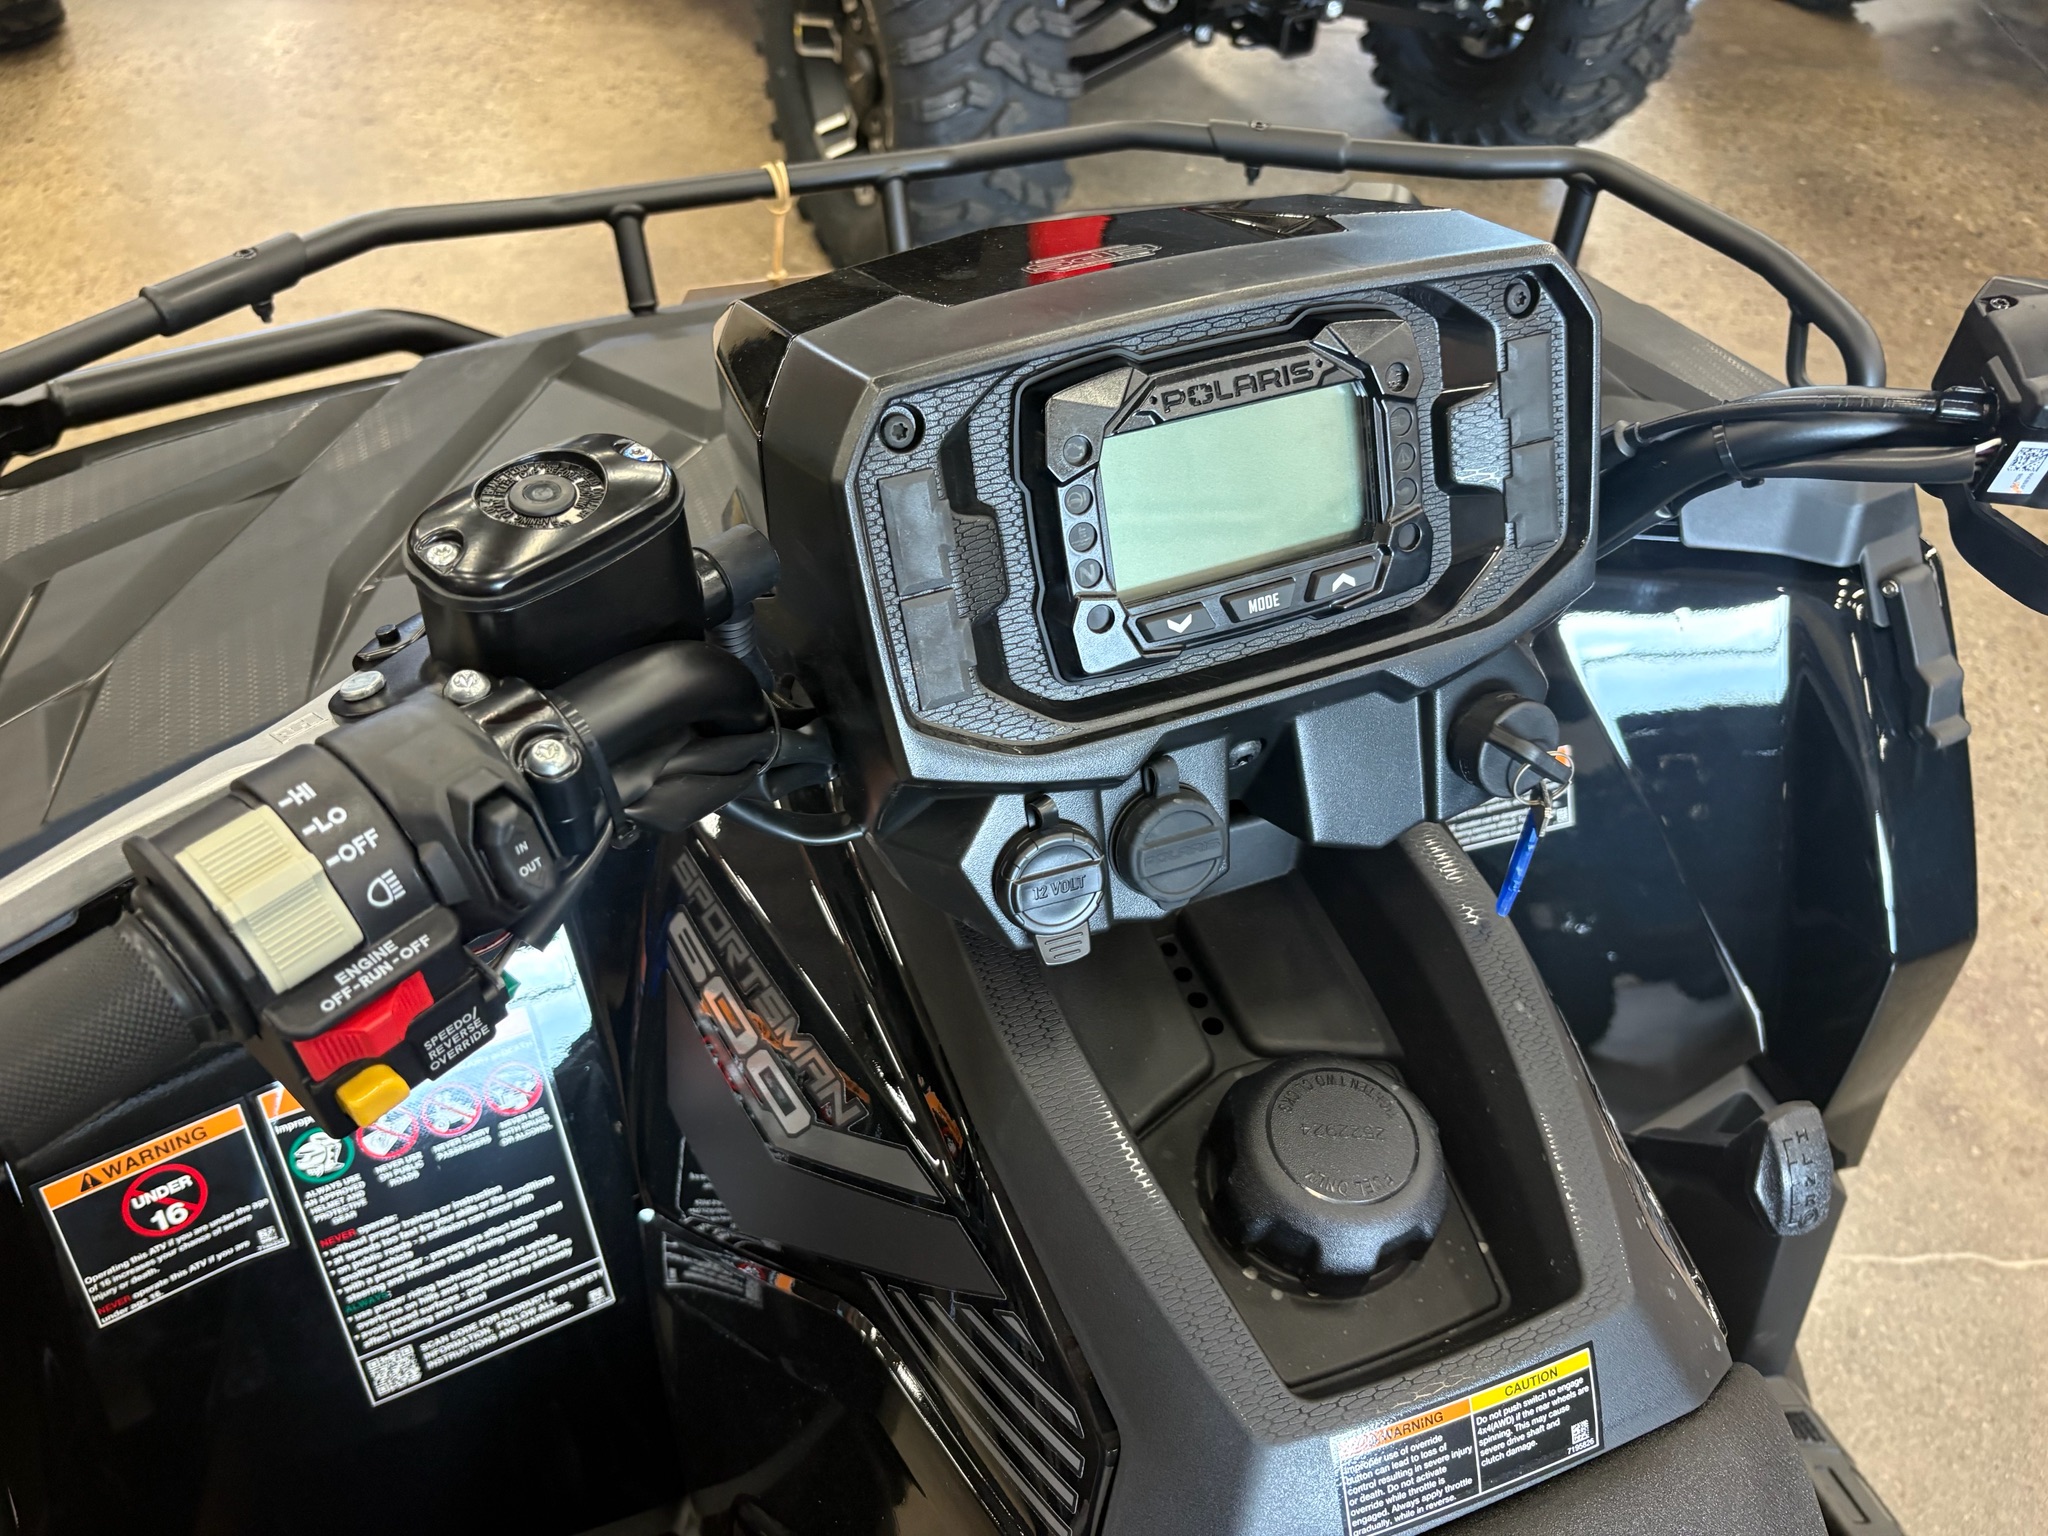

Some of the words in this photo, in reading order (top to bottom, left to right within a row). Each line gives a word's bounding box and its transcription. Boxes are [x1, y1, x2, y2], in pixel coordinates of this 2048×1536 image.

[1160, 359, 1314, 413] POLARIS
[1248, 592, 1280, 615] MODE
[289, 781, 317, 807] HI
[316, 807, 348, 830] LO
[337, 827, 380, 862] OFF
[514, 840, 530, 856] IN
[519, 857, 543, 878] OUT
[1032, 885, 1048, 901] 12
[1051, 875, 1087, 897] VOLT
[334, 940, 399, 986] ENGINE
[672, 852, 864, 1127] SPORTSMAN
[423, 1006, 478, 1051] SPEEDO/
[428, 1017, 483, 1061] REVERSE
[430, 1025, 491, 1072] OVERRIDE
[274, 1114, 315, 1135] Improp
[1796, 1128, 1809, 1143] H
[101, 1124, 208, 1180] WARNING
[1802, 1153, 1813, 1165] L
[129, 1173, 194, 1210] UNDER
[1804, 1173, 1817, 1187] N
[149, 1201, 187, 1231] 16
[1805, 1194, 1816, 1207] R
[319, 1227, 357, 1249] NEVER
[1504, 1366, 1557, 1397] CAUTION
[1475, 1414, 1487, 1425] Do
[1488, 1408, 1501, 1420] not
[1502, 1401, 1522, 1416] push
[1522, 1391, 1546, 1407] switch
[1548, 1387, 1556, 1397] to
[1556, 1376, 1583, 1394] engage
[1515, 1411, 1521, 1420] if
[1522, 1406, 1534, 1418] the
[1535, 1401, 1550, 1412] rear
[1551, 1389, 1576, 1406] wheels
[1577, 1385, 1589, 1395] are
[1382, 1410, 1443, 1442] WARNING
[1478, 1426, 1513, 1448] spinning.
[1513, 1419, 1530, 1432] This
[1531, 1414, 1547, 1427] may
[1548, 1404, 1570, 1418] cause
[1479, 1441, 1505, 1457] severe
[1506, 1431, 1525, 1446] drive
[1526, 1423, 1545, 1438] shaft
[1545, 1417, 1560, 1430] and
[1374, 1465, 1390, 1476] can
[1391, 1456, 1409, 1470] lead
[1410, 1453, 1419, 1463] to
[1420, 1445, 1437, 1459] loss
[1438, 1442, 1447, 1453] of
[1383, 1450, 1398, 1462] use
[1400, 1445, 1408, 1456] of
[1410, 1433, 1443, 1453] override
[1480, 1450, 1504, 1467] clutch
[1505, 1438, 1537, 1458] damage.
[1377, 1465, 1412, 1488] resulting
[1414, 1462, 1422, 1472] in
[1423, 1453, 1449, 1469] severe
[1451, 1443, 1472, 1461] injury
[1349, 1498, 1358, 1507] or
[1359, 1485, 1385, 1504] death.
[1387, 1482, 1399, 1494] Do
[1400, 1477, 1414, 1489] not
[1415, 1464, 1447, 1484] activate
[1350, 1498, 1384, 1518] override
[1385, 1489, 1406, 1505] while
[1407, 1478, 1436, 1497] throttle
[1437, 1475, 1445, 1486] is
[1351, 1506, 1389, 1530] engaged.
[1391, 1495, 1419, 1514] Always
[1421, 1486, 1443, 1504] apply
[1444, 1475, 1472, 1494] throttle
[1394, 1508, 1415, 1522] while
[1416, 1504, 1424, 1514] in
[1425, 1492, 1456, 1511] reverse.
